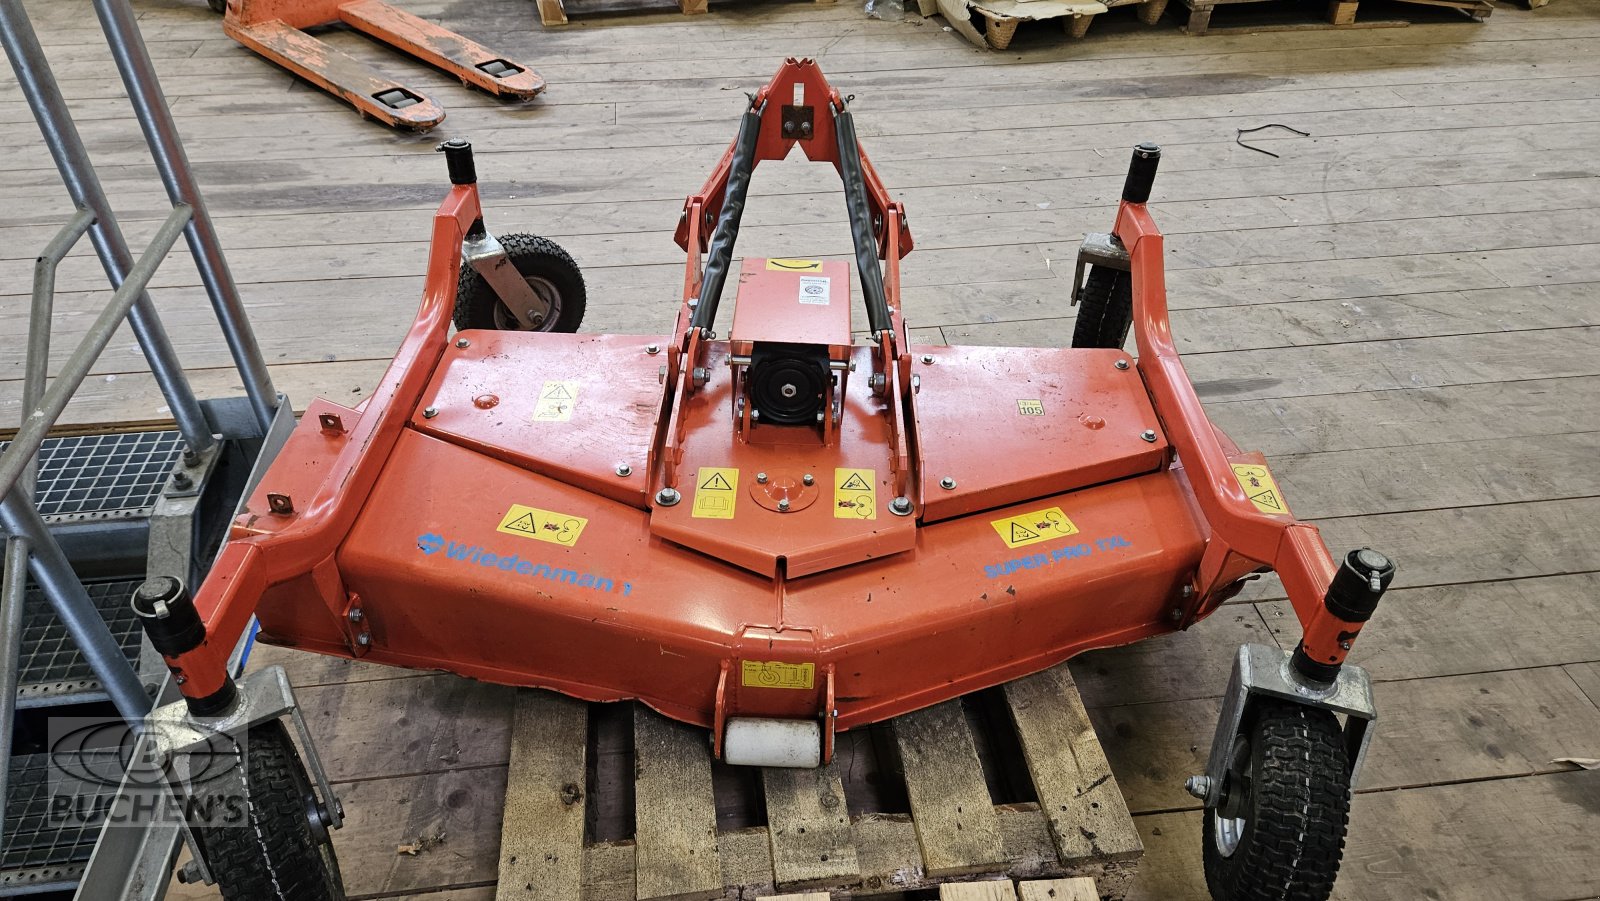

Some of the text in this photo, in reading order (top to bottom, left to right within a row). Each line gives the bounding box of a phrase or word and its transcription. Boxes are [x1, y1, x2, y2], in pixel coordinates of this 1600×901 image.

[1020, 406, 1043, 415] 105
[984, 553, 1049, 579] SUPER
[1051, 543, 1092, 563] PRO
